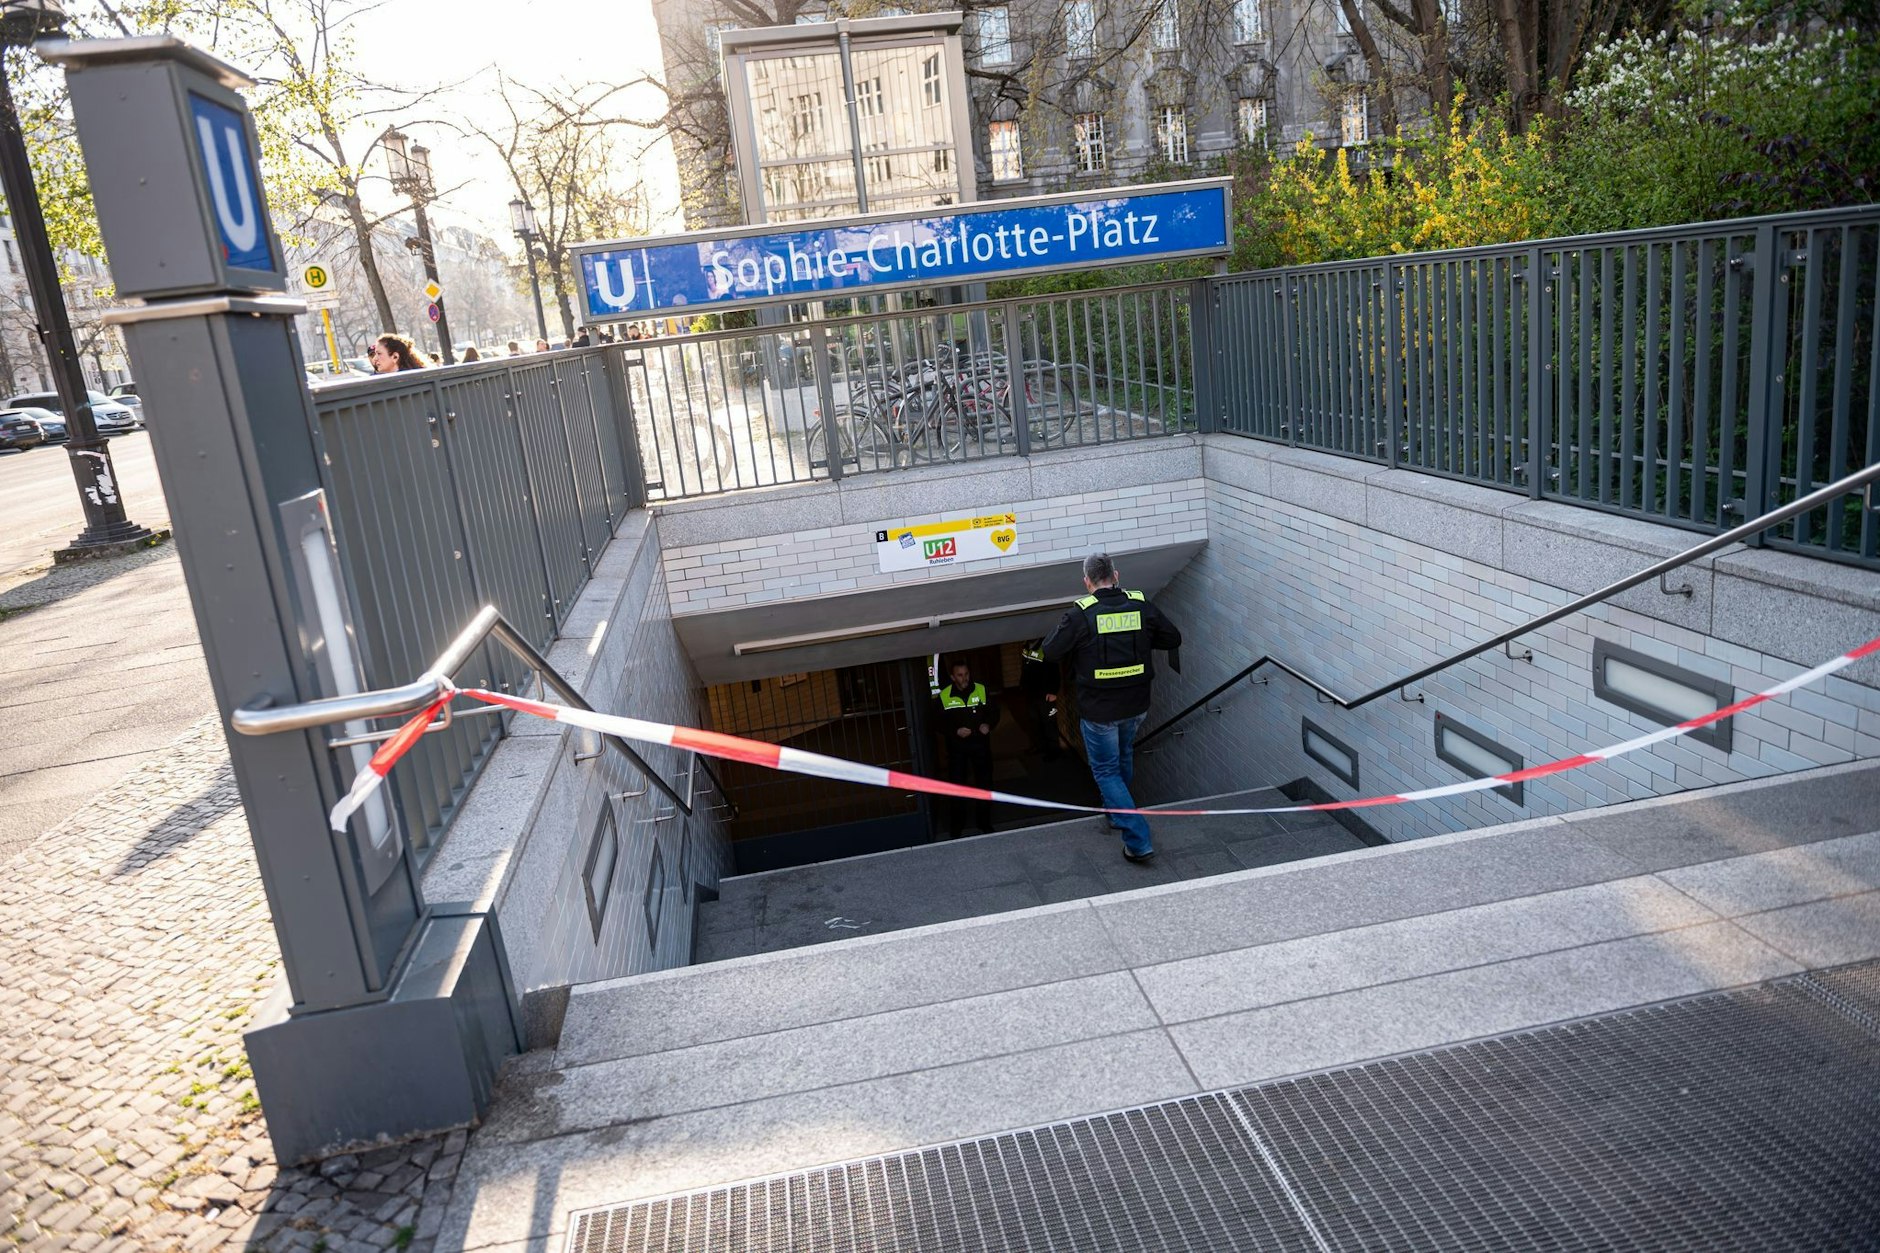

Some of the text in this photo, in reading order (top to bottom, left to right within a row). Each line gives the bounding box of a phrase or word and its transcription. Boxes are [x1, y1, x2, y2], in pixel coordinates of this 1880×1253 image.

[197, 115, 257, 252] U
[594, 210, 1159, 307] U Sophie-Charlotte-Platz
[879, 532, 885, 541] B
[997, 535, 1010, 543] BVG
[925, 540, 954, 557] U12
[929, 557, 954, 565] Ruhleben
[1099, 612, 1140, 632] POLIZEI
[1099, 667, 1141, 677] Pressesprecher
